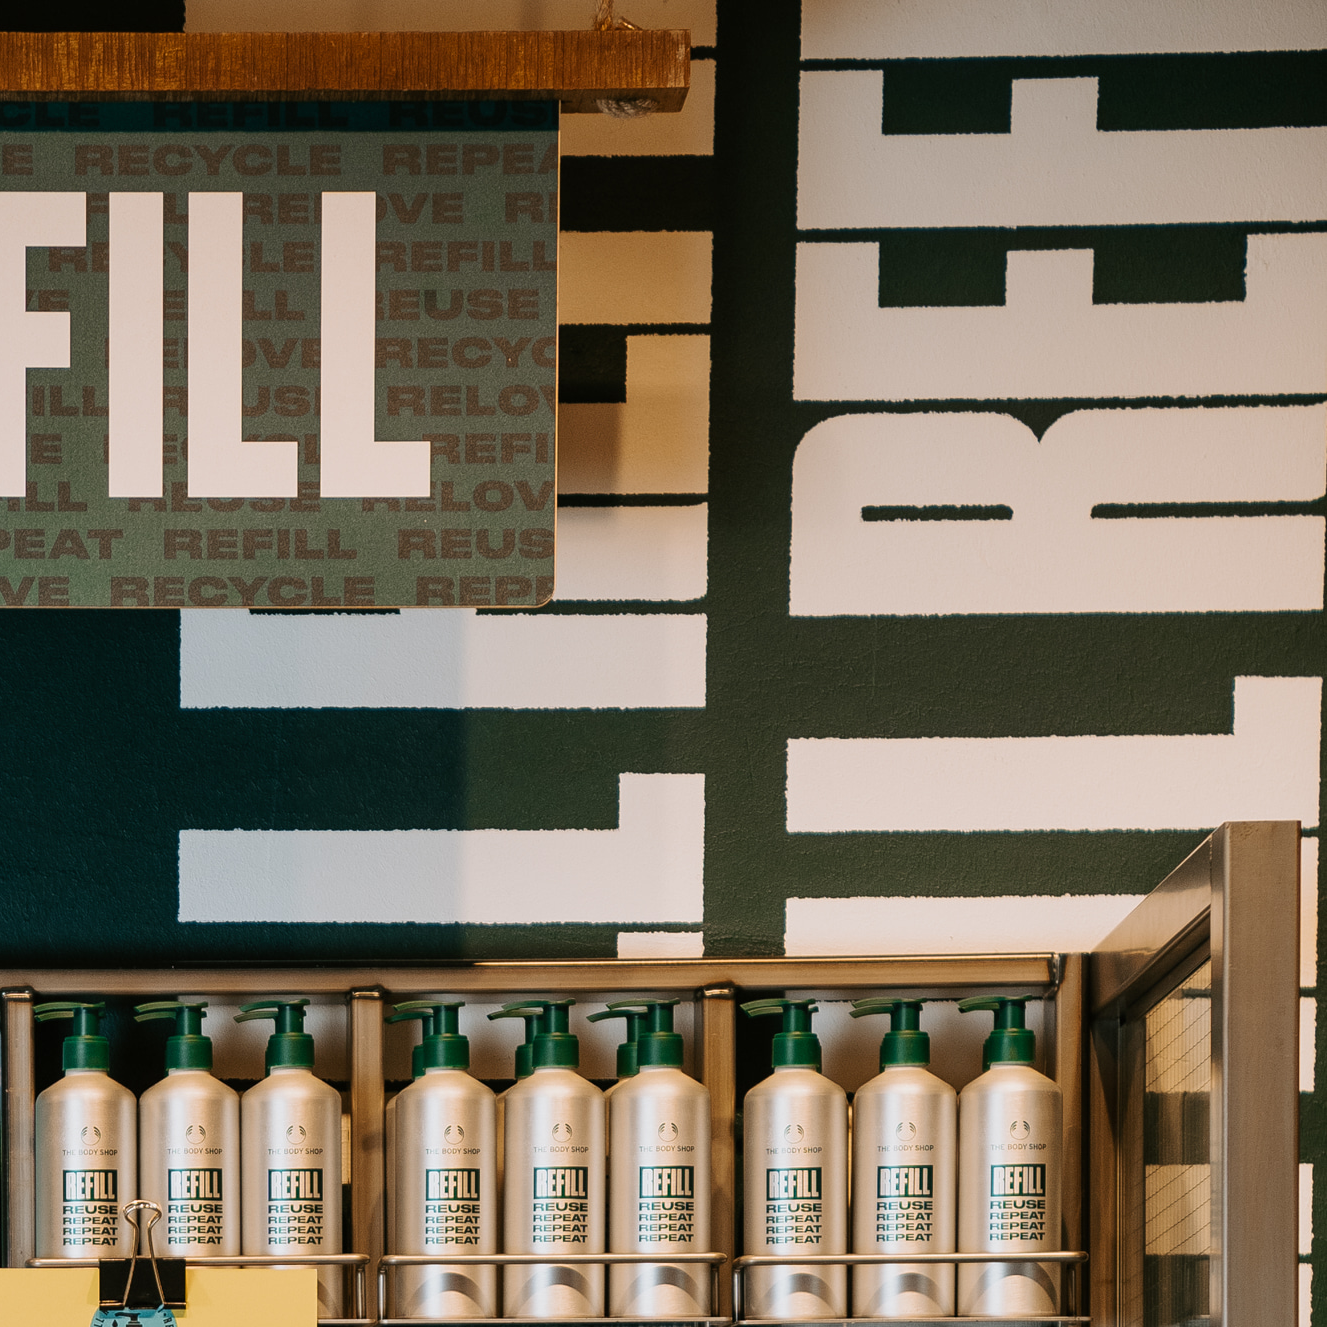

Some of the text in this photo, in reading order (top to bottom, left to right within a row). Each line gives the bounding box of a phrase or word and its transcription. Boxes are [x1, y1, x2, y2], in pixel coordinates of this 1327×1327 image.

[74, 144, 342, 176] RECYCLE
[163, 528, 358, 560] REFILL
[66, 1171, 115, 1200] REFILL
[62, 1204, 119, 1215] REUSE
[62, 1217, 119, 1225] REPEAT
[62, 1227, 119, 1236] REPEAT
[62, 1237, 119, 1246] REPEAT
